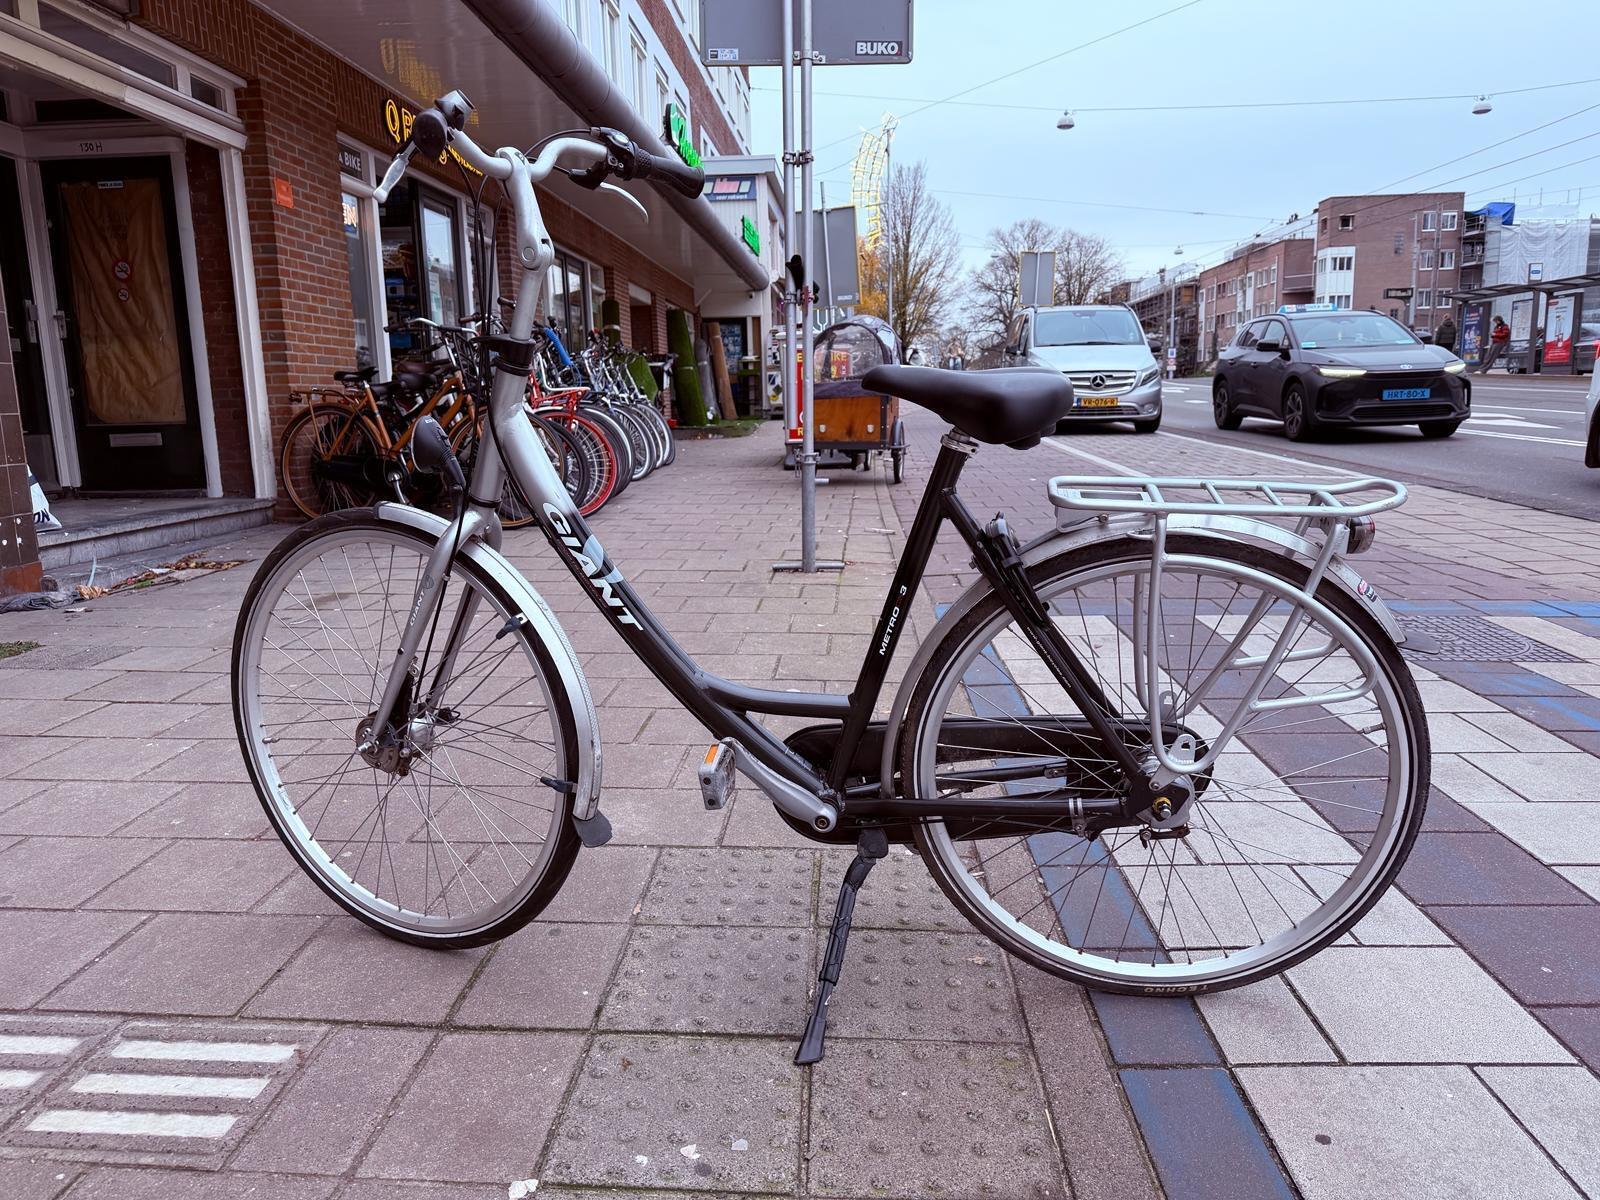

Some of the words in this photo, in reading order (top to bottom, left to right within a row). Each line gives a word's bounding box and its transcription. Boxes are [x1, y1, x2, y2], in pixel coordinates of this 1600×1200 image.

[856, 41, 899, 55] BUKO
[80, 142, 94, 152] 130
[344, 151, 362, 172] BIKE
[542, 501, 645, 632] GIANT
[410, 589, 425, 627] GIANT
[879, 606, 901, 656] METRO
[899, 584, 908, 597] 3
[1143, 983, 1210, 994] TECHNO
